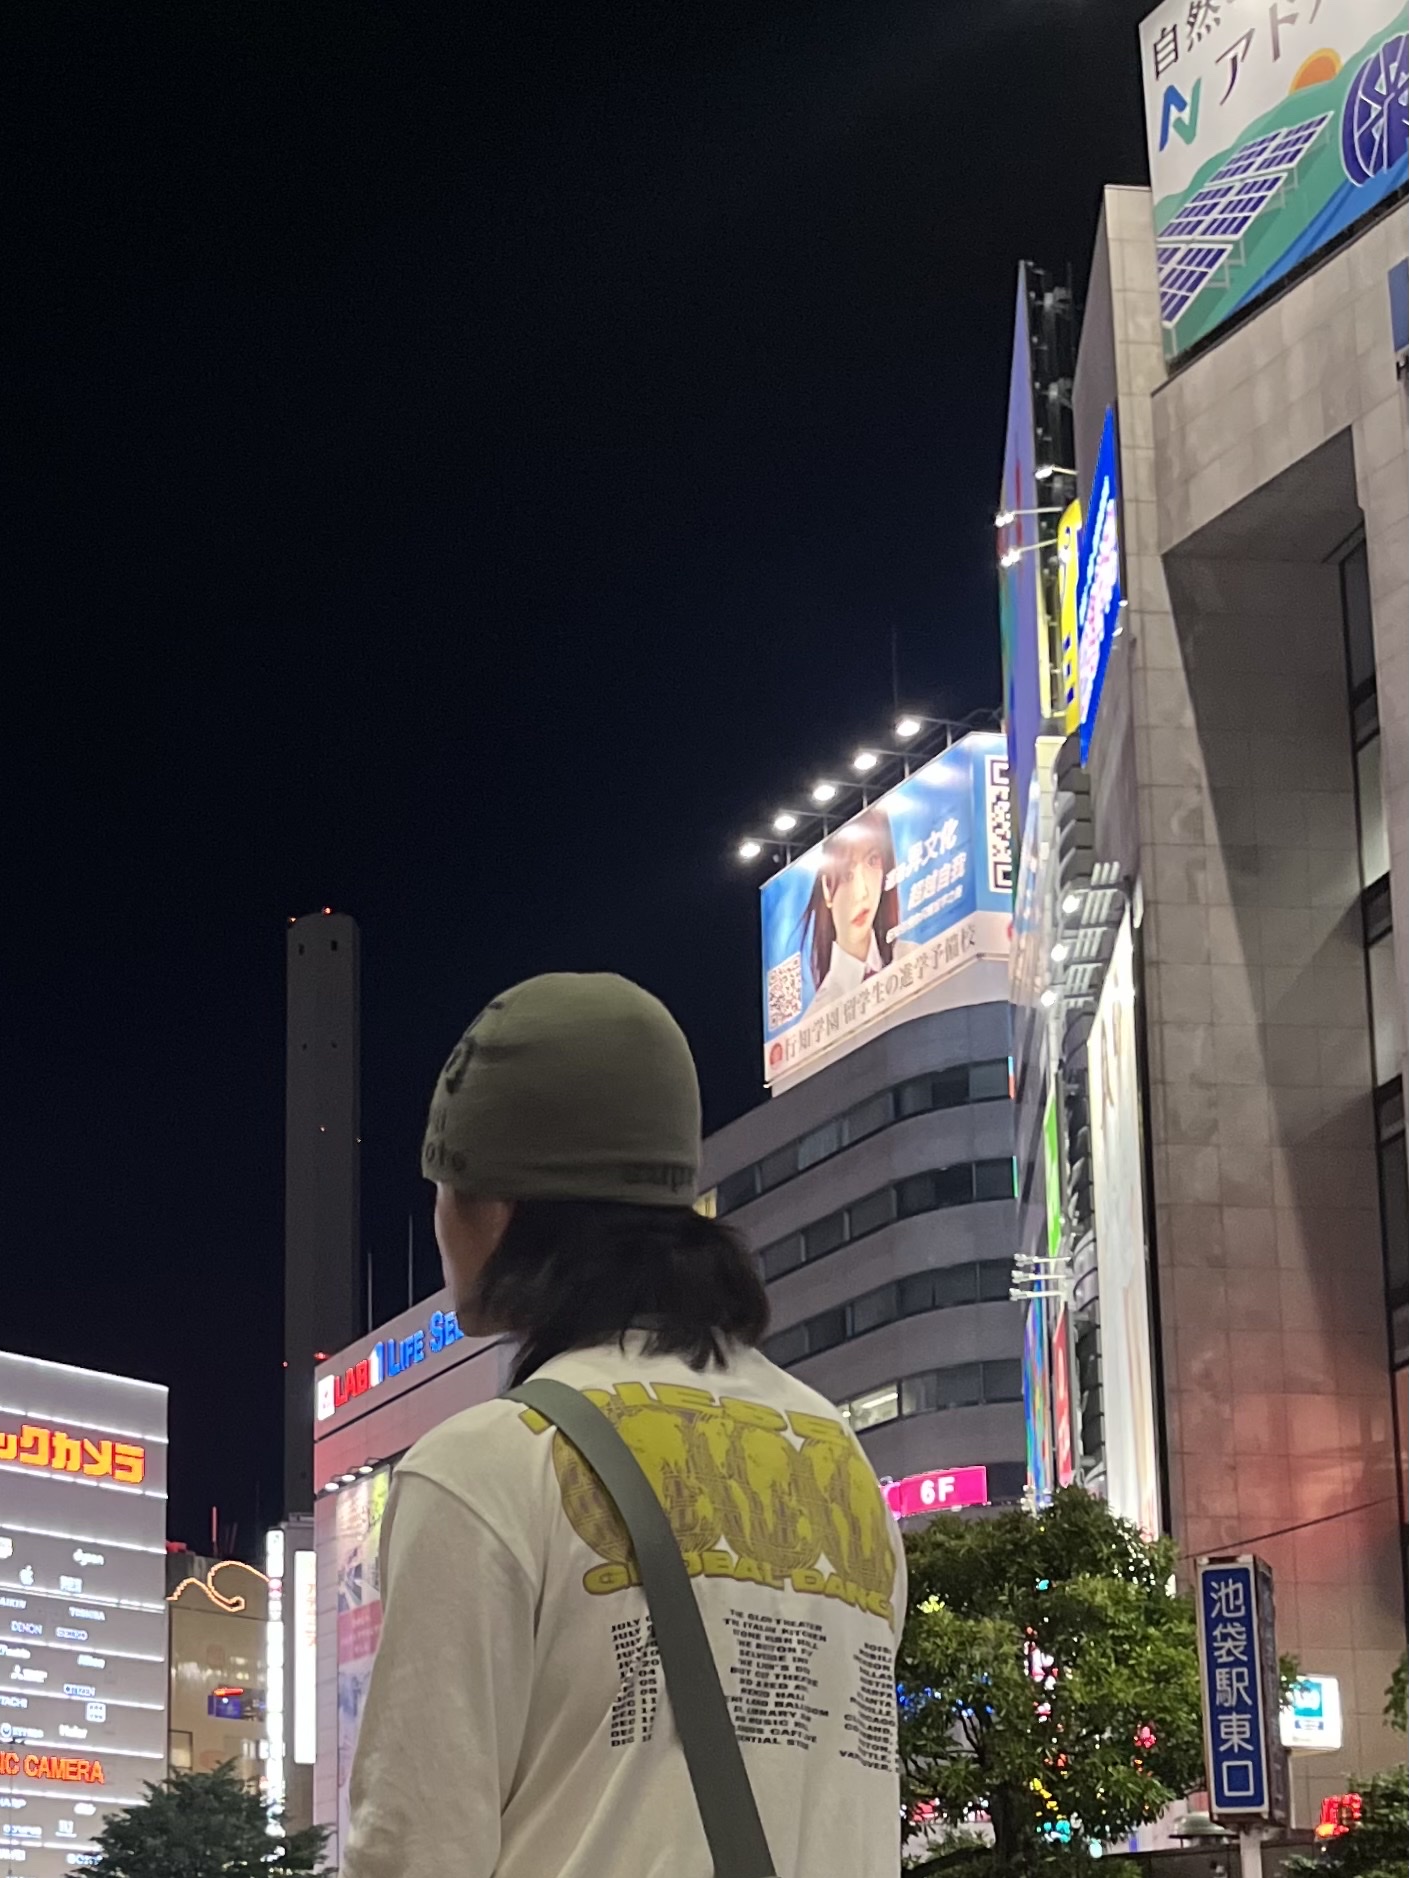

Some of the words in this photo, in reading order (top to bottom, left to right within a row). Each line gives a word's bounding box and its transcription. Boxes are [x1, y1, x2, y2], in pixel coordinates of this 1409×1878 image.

[1153, 0, 1232, 81] 自然
[387, 1329, 425, 1377] LIFE
[428, 1310, 465, 1353] SEL
[920, 1476, 955, 1505] 6F
[1209, 1577, 1255, 1798] 池袋駅東口
[23, 1754, 105, 1784] CAMERA
